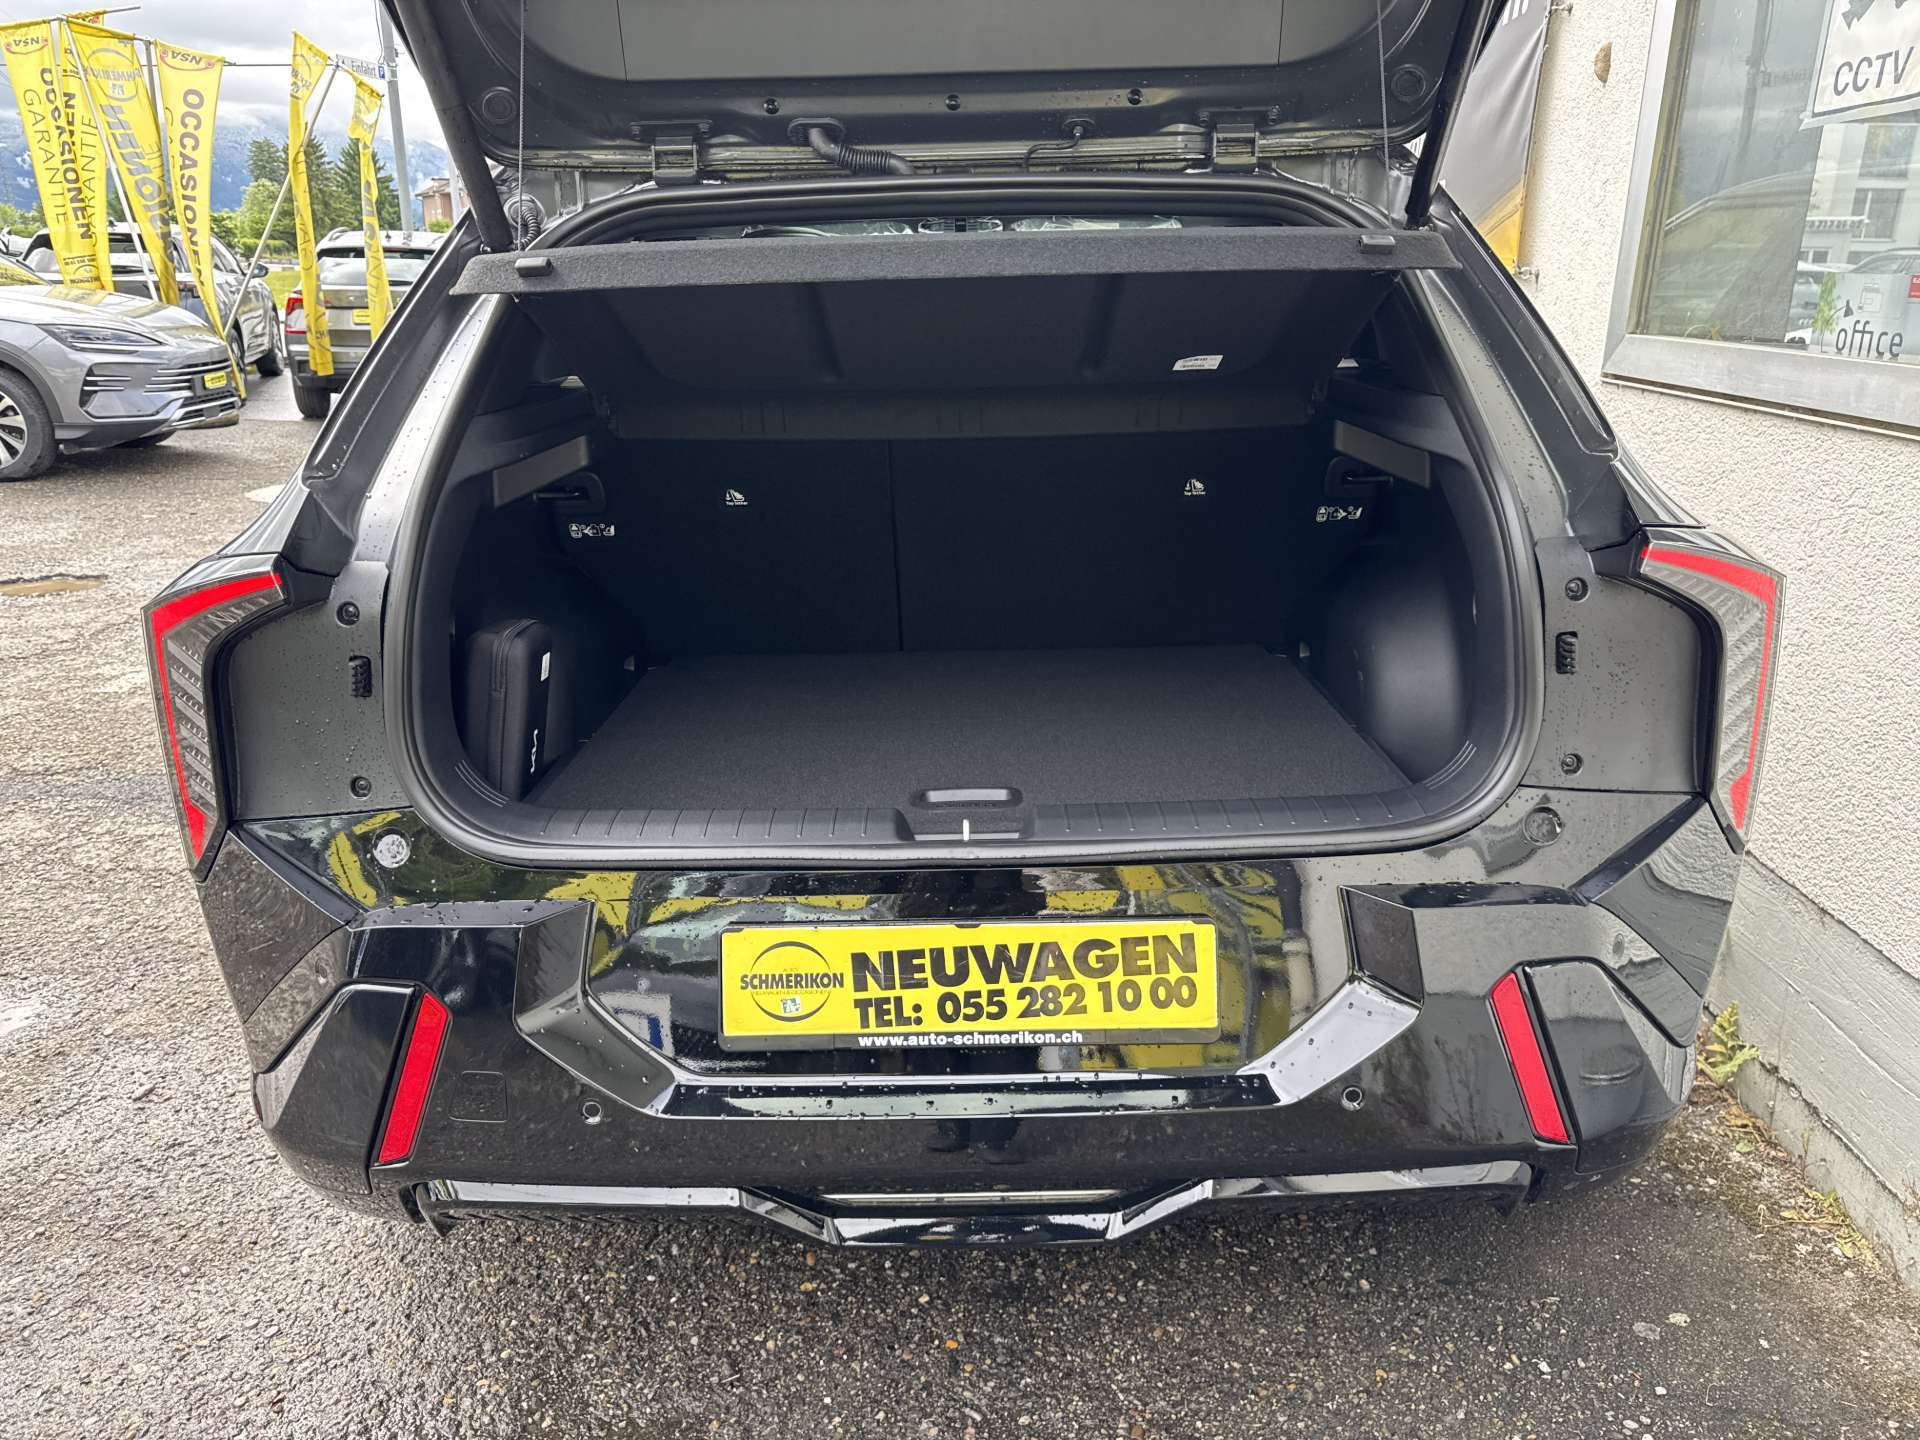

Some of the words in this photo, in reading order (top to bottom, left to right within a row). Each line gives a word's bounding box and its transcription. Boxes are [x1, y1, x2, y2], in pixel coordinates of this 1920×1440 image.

[13, 37, 40, 47] NSA
[171, 50, 202, 65] NSA
[1833, 46, 1914, 96] CCTV
[1836, 319, 1904, 358] office
[850, 933, 1198, 992] NEUWAGEN
[740, 972, 844, 990] SCHMERIKON
[853, 996, 923, 1029] TEL:
[937, 989, 1008, 1024] 055
[1016, 983, 1087, 1018] 282
[1097, 979, 1142, 1012] 10
[1149, 975, 1198, 1009] 00
[858, 1031, 1083, 1047] www.auto-schmerikon.ch
